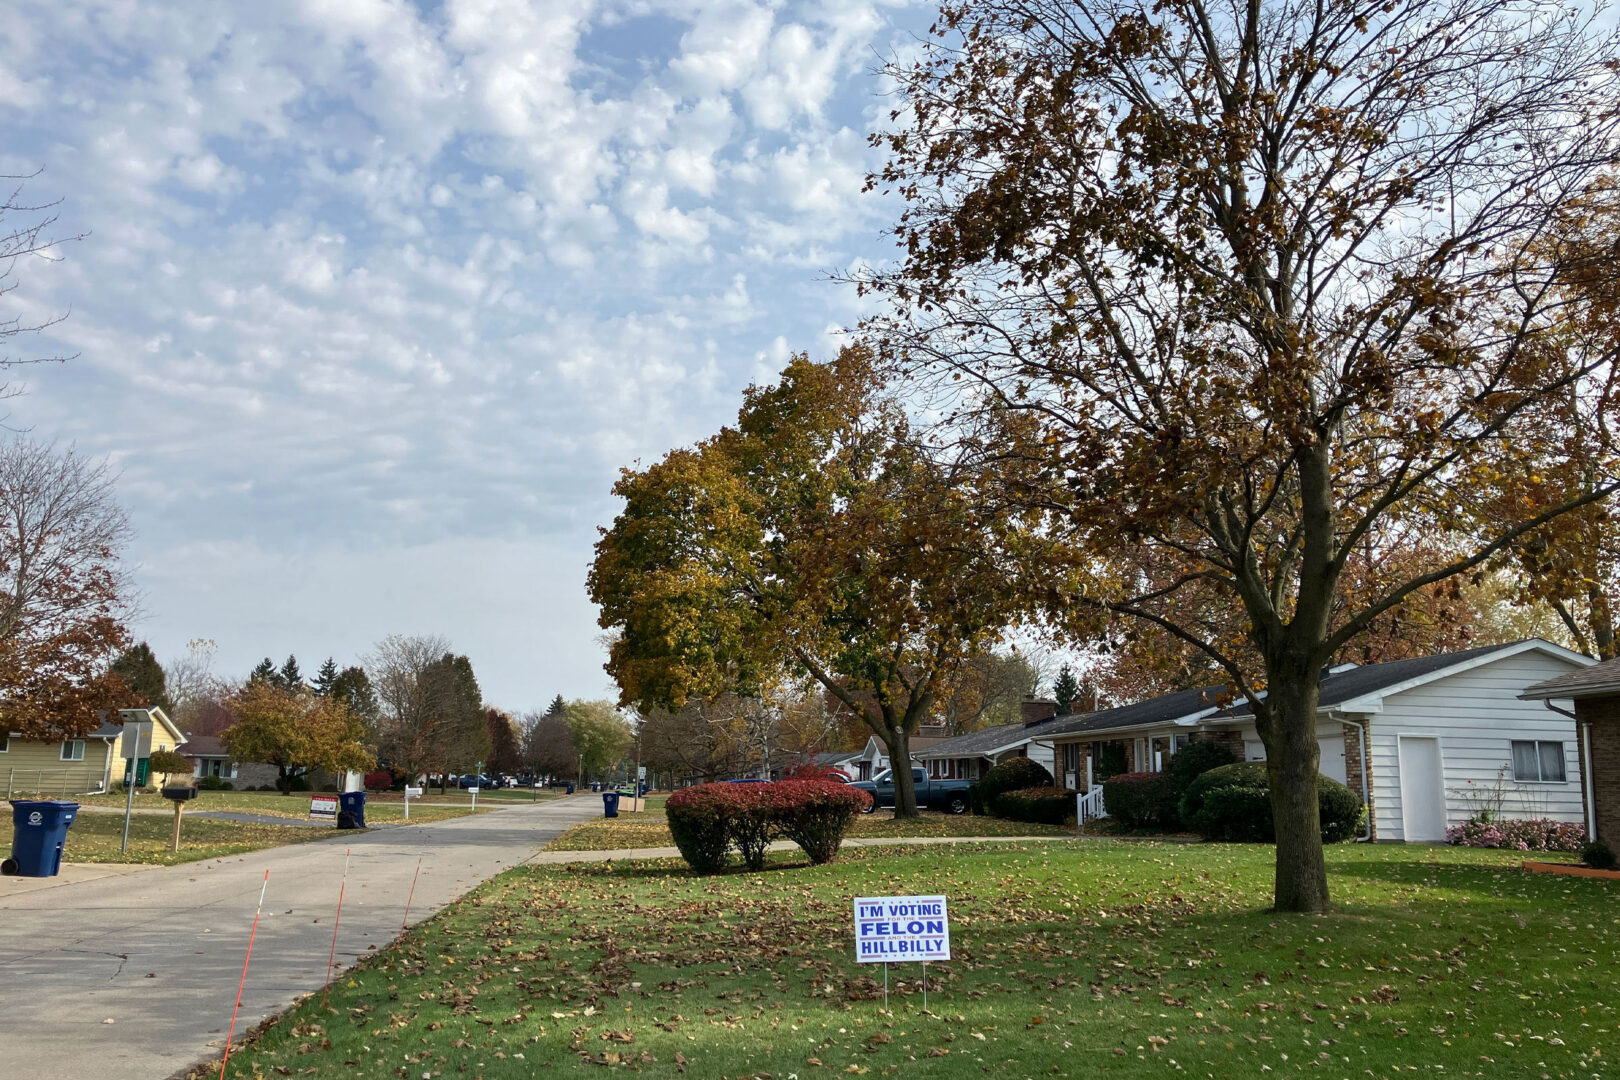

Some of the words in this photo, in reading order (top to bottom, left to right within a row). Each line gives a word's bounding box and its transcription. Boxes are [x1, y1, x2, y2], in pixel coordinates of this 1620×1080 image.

[860, 906, 883, 917] I'M
[889, 904, 941, 916] VOTING
[861, 921, 944, 936] FELON
[862, 940, 943, 954] HILLBILLY
